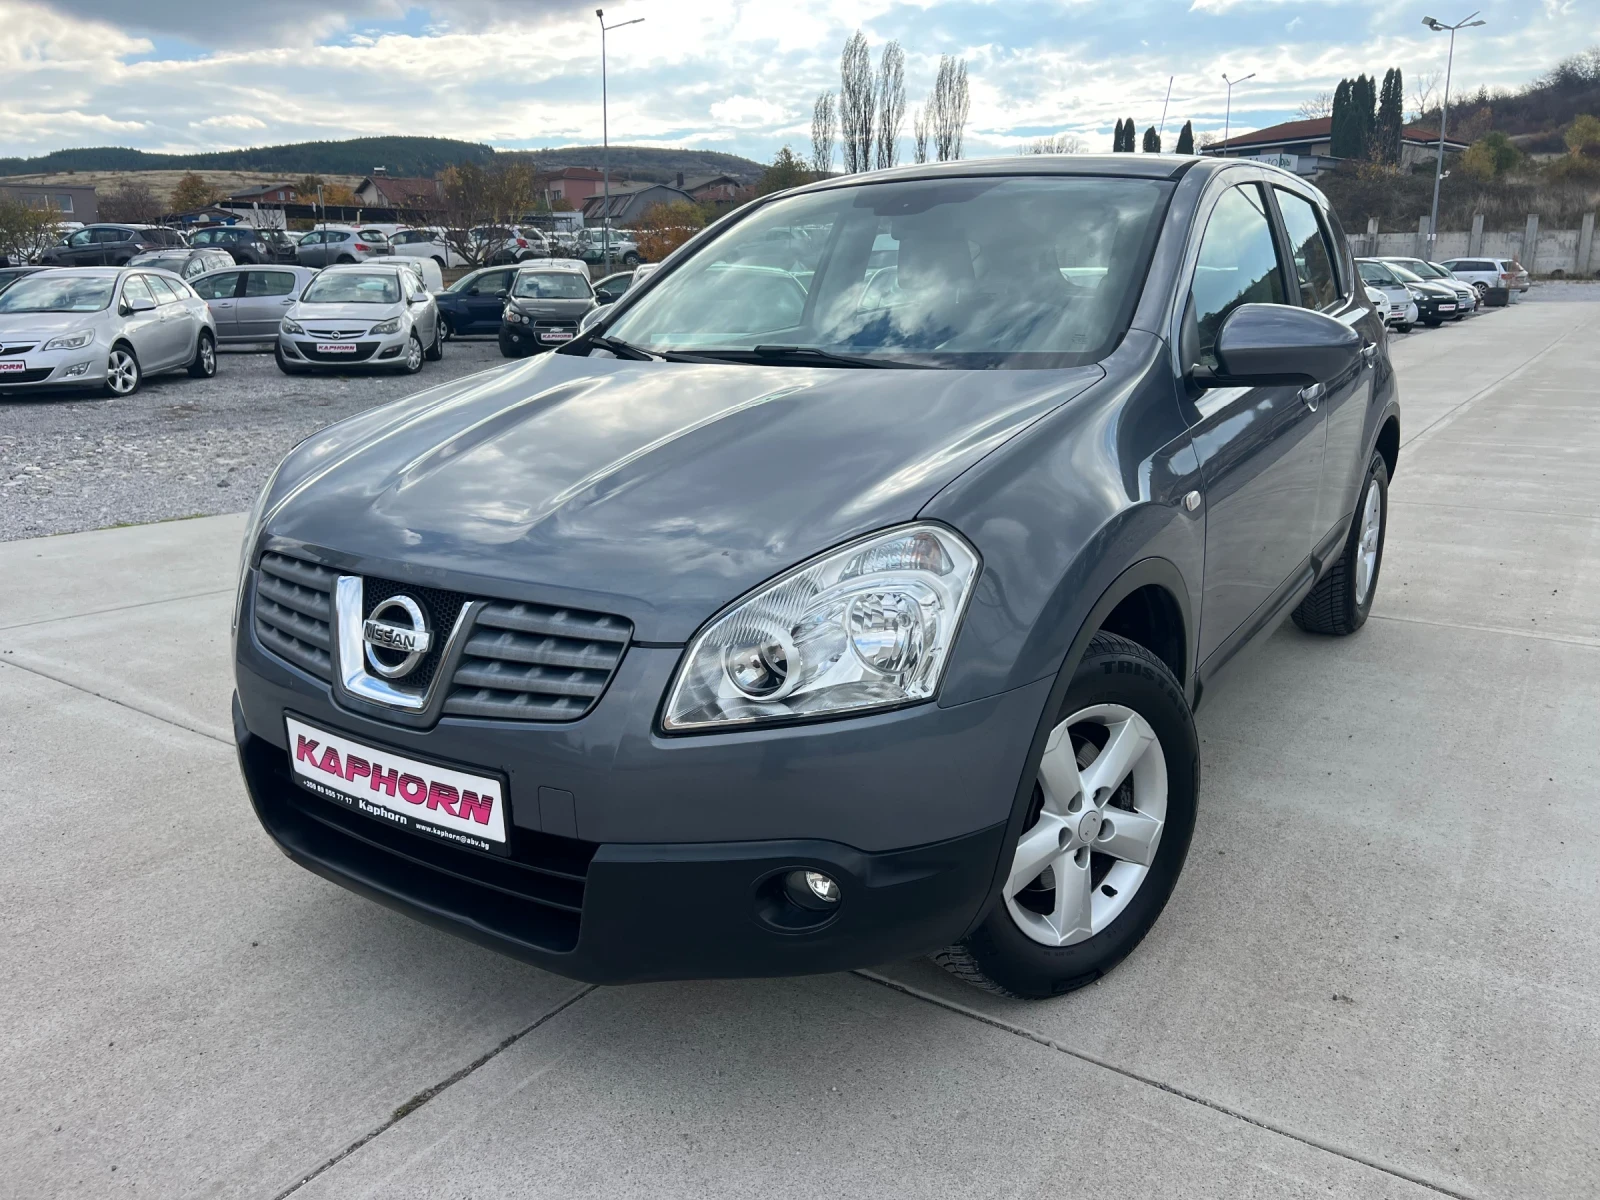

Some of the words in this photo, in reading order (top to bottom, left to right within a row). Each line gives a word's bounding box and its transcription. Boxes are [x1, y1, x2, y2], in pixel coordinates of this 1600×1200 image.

[364, 621, 416, 649] NISSAN
[296, 734, 494, 826] KAPHORN
[345, 797, 353, 805] 17
[358, 799, 408, 825] Kaphorn
[415, 823, 490, 851] www.kaphorn@abv.bg
